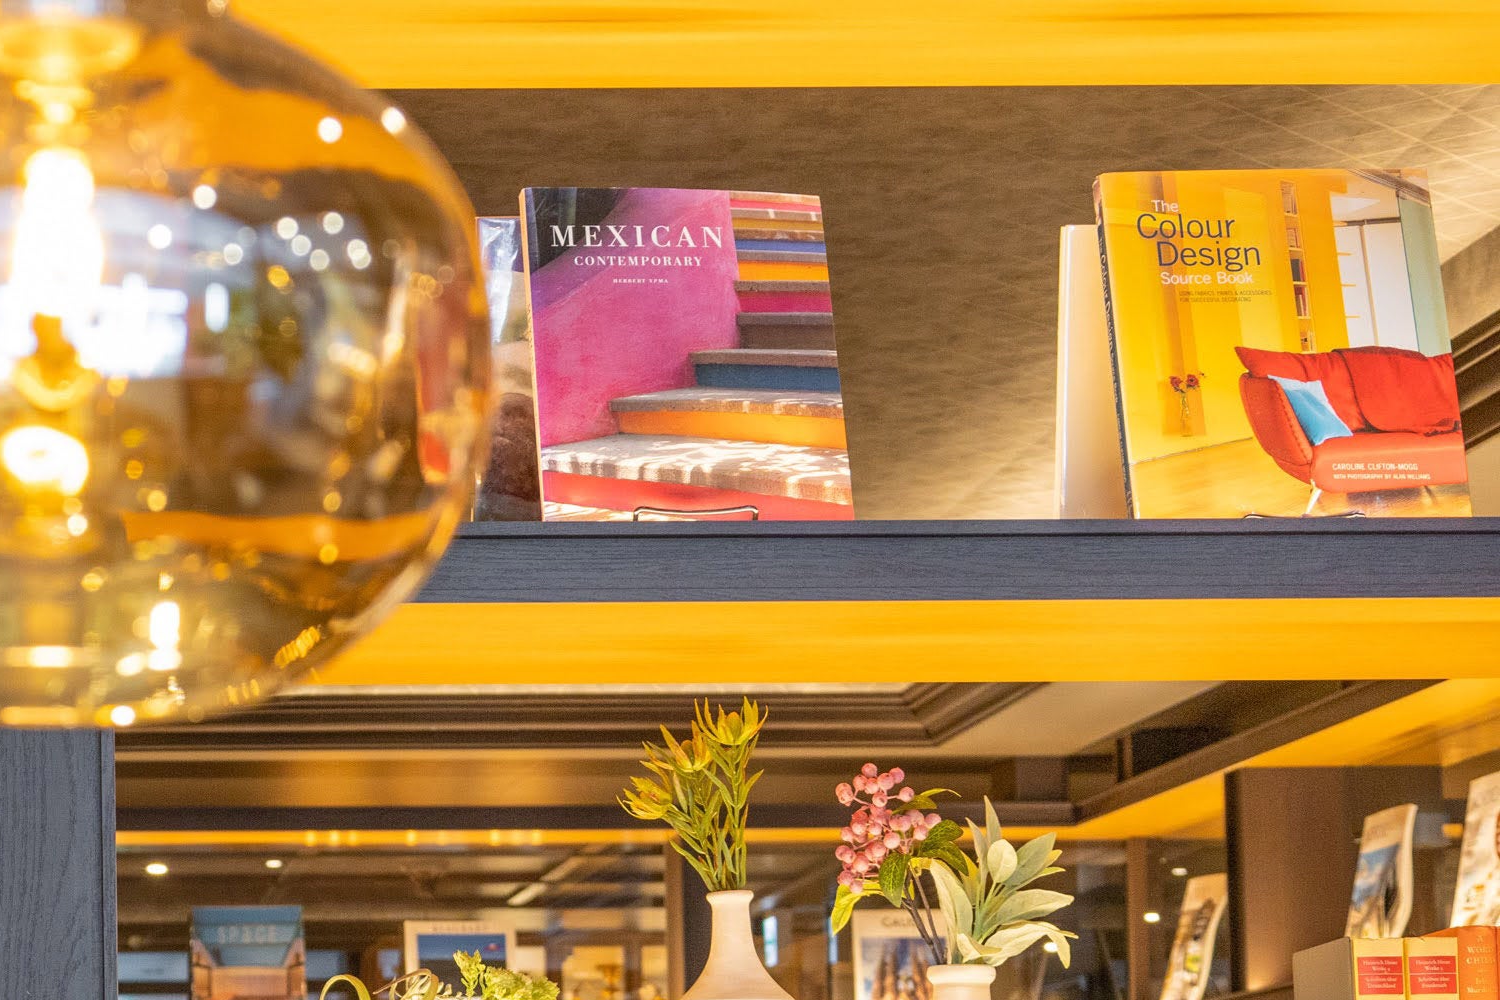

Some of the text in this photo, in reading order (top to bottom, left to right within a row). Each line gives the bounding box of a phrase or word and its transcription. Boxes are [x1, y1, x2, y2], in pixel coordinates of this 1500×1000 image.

[1151, 199, 1179, 212] The
[1137, 213, 1235, 238] Colour
[549, 225, 723, 249] MEXICAN
[574, 255, 703, 267] CONTEMPORARY
[1157, 240, 1260, 272] Design
[1160, 271, 1254, 285] Source Book
